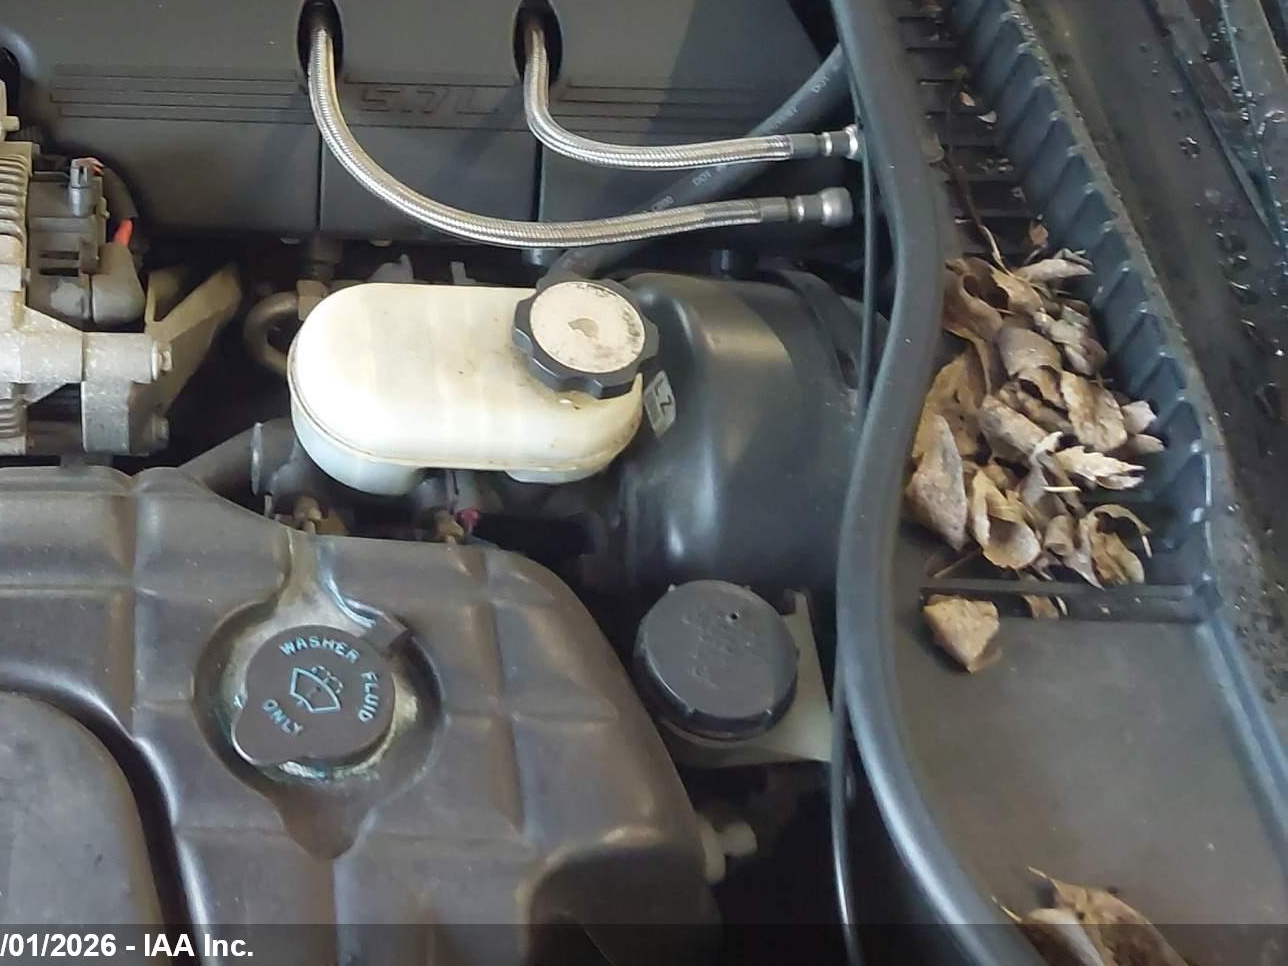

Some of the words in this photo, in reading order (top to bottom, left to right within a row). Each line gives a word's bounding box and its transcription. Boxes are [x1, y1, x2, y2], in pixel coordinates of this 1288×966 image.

[279, 636, 361, 664] WASHER
[357, 671, 380, 723] FLUID
[263, 698, 304, 735] ONLY
